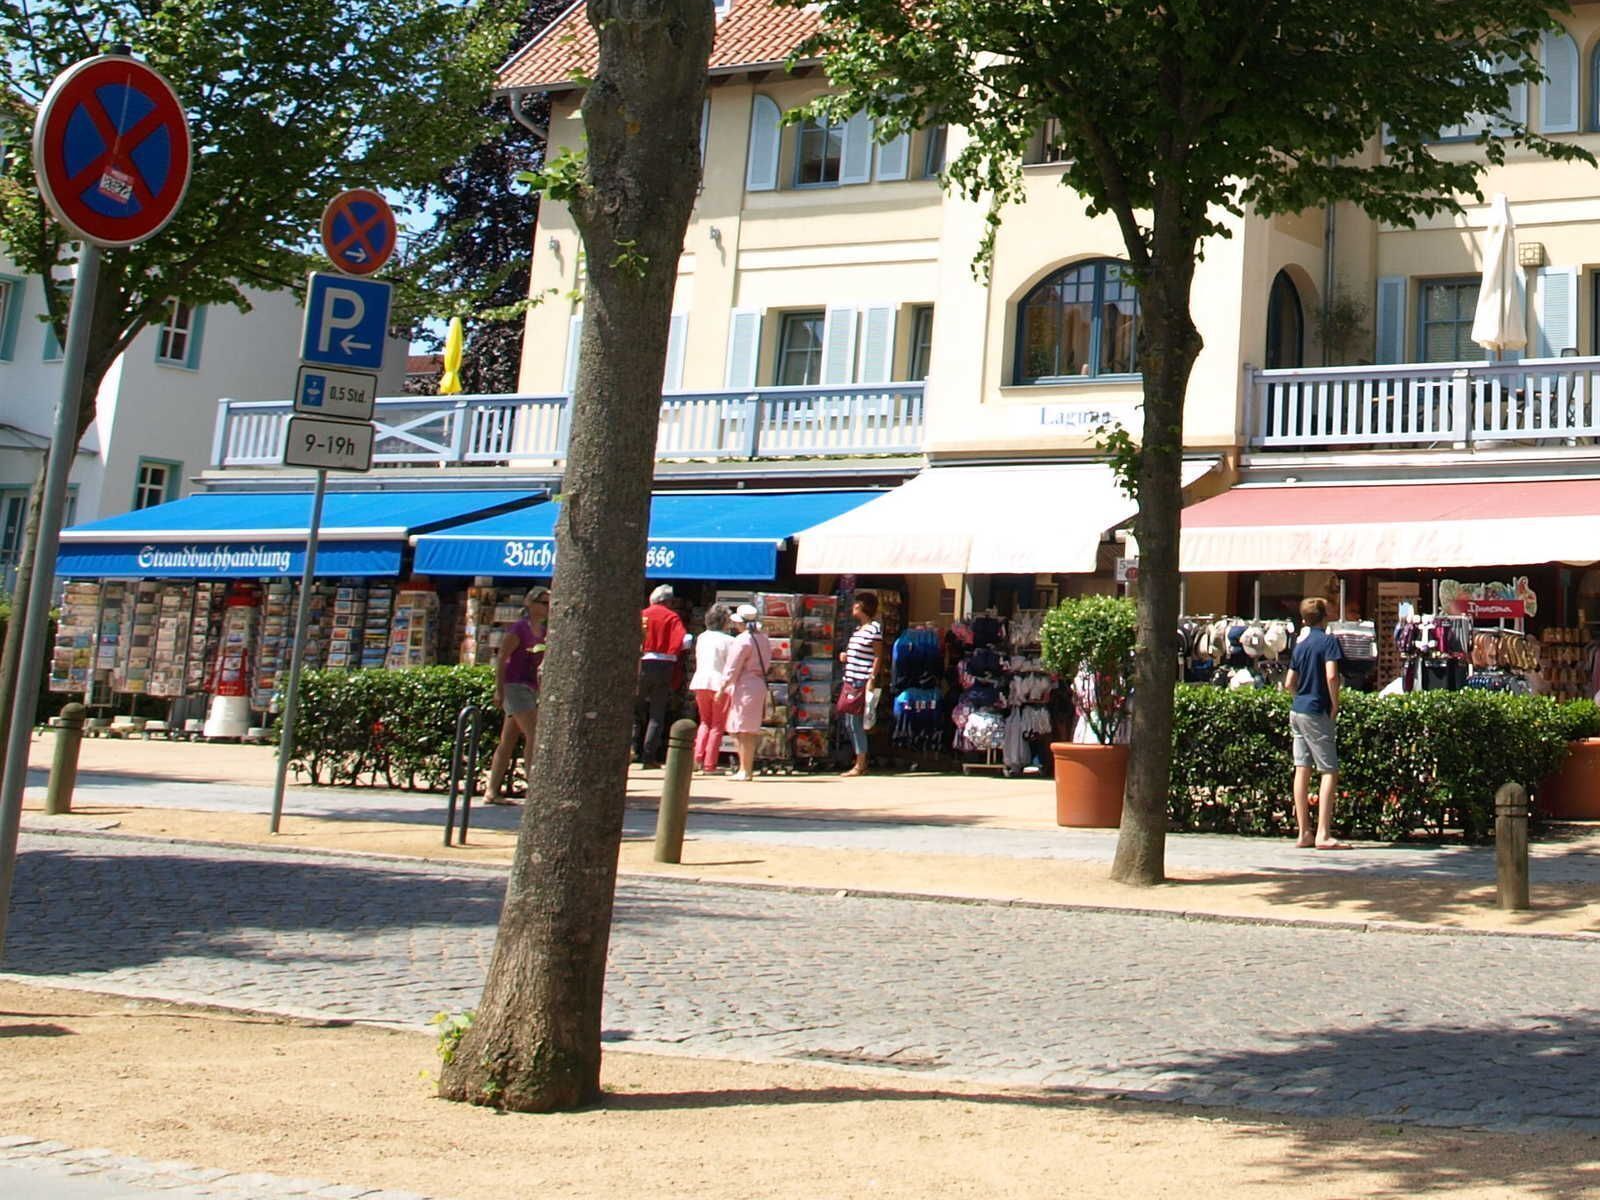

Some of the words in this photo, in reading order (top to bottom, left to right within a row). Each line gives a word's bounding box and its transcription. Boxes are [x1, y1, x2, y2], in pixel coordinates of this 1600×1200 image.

[318, 287, 365, 353] P
[305, 434, 354, 456] 9-19h
[138, 545, 291, 572] Strandbuchhandlung
